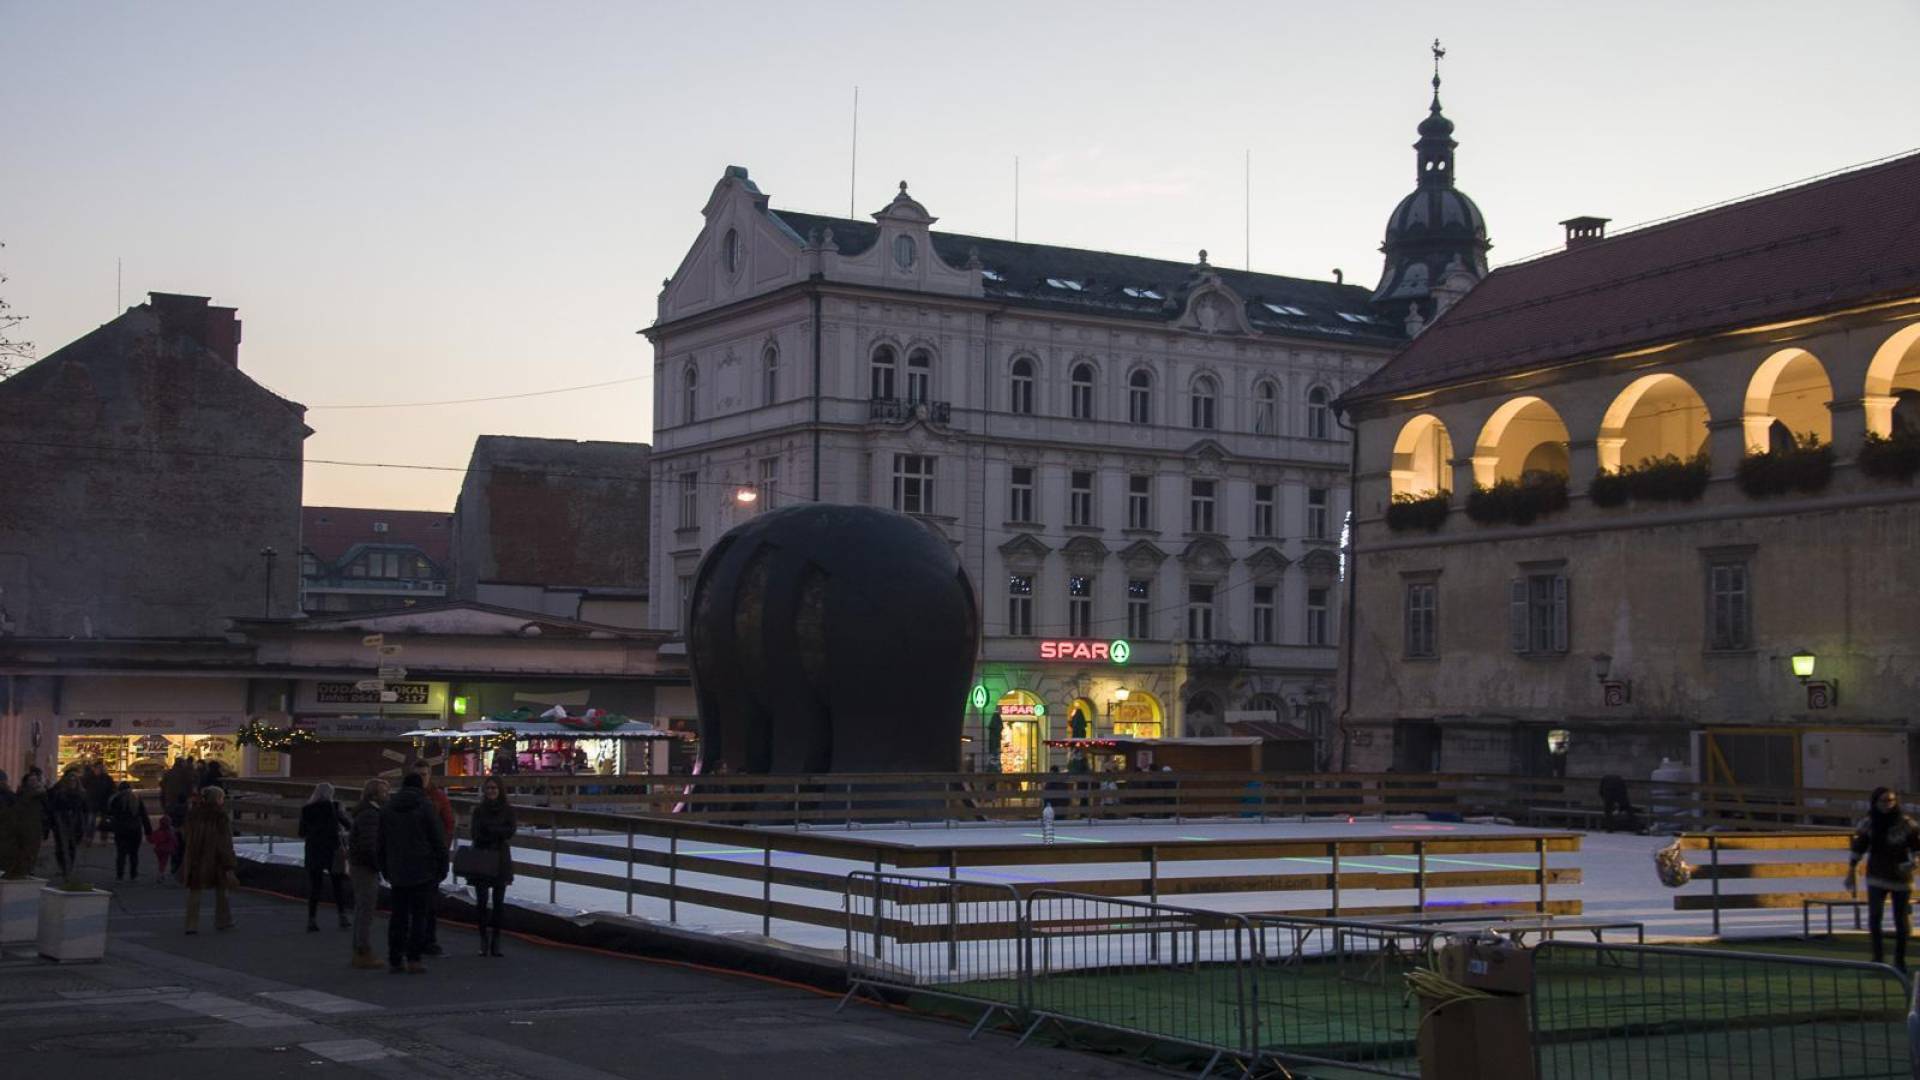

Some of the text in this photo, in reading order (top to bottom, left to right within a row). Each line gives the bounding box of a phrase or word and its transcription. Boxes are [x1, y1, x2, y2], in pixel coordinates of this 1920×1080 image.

[1040, 641, 1109, 660] SPAR
[319, 684, 382, 694] ODDA
[1001, 705, 1034, 714] SPAR
